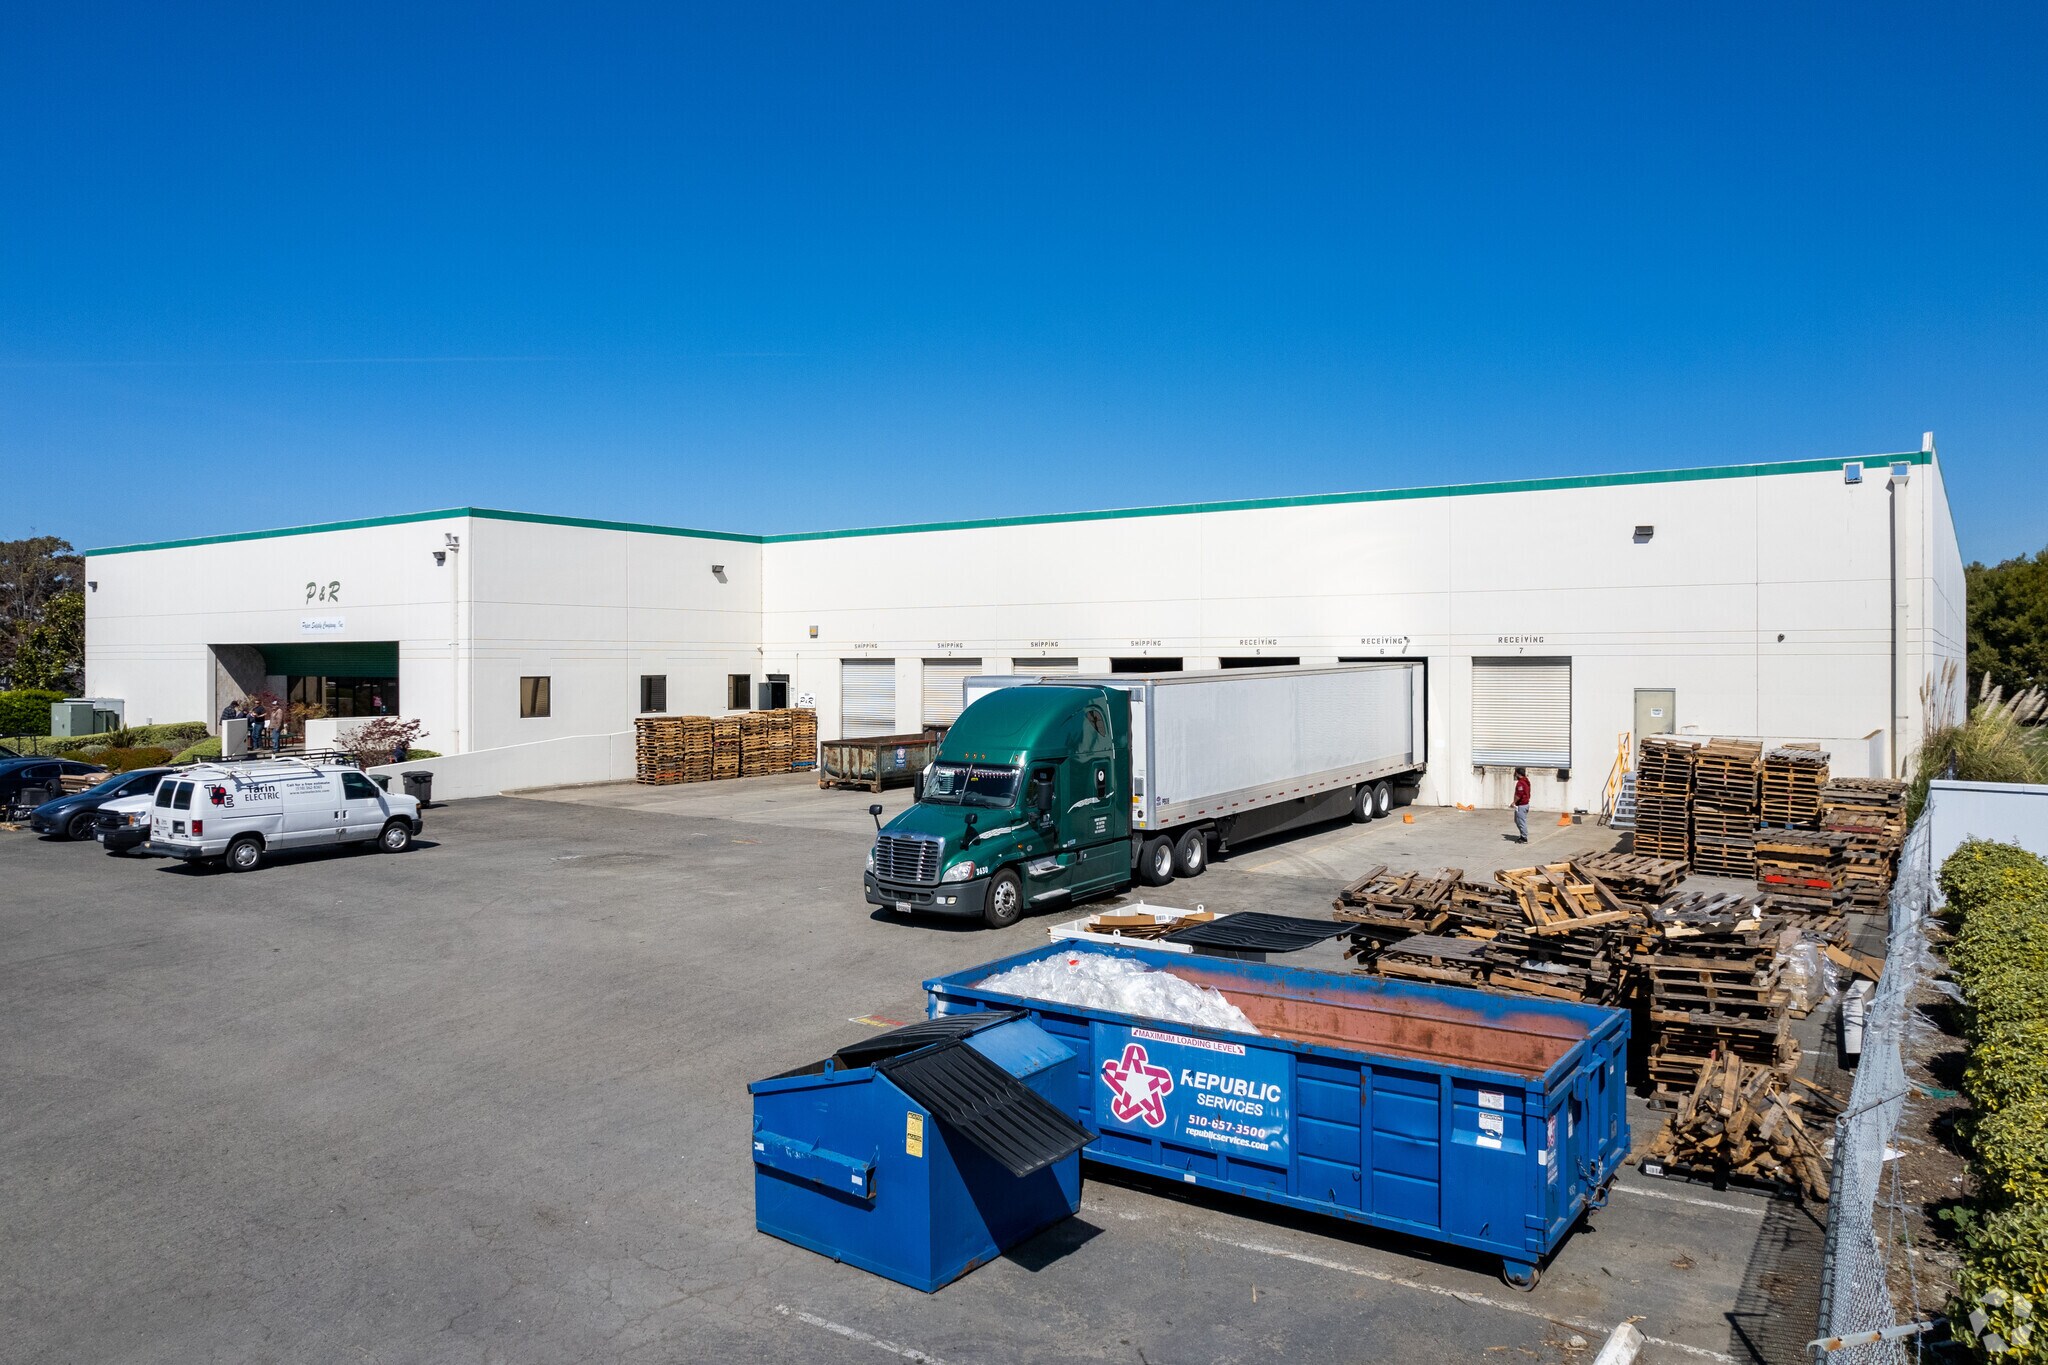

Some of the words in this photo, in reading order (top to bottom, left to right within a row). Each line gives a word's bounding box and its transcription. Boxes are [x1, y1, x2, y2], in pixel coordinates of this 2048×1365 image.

[244, 792, 280, 802] ELECTRIC
[247, 783, 275, 794] Tarin
[1138, 1030, 1175, 1043] MAXIMUM
[1176, 1036, 1212, 1049] LOADING
[1213, 1042, 1237, 1053] LEVEL
[1180, 1068, 1281, 1103] REPUBLIC
[1196, 1093, 1264, 1117] SERVICES
[1188, 1114, 1266, 1138] 510-657-3500
[1185, 1127, 1269, 1151] republicservices.com
